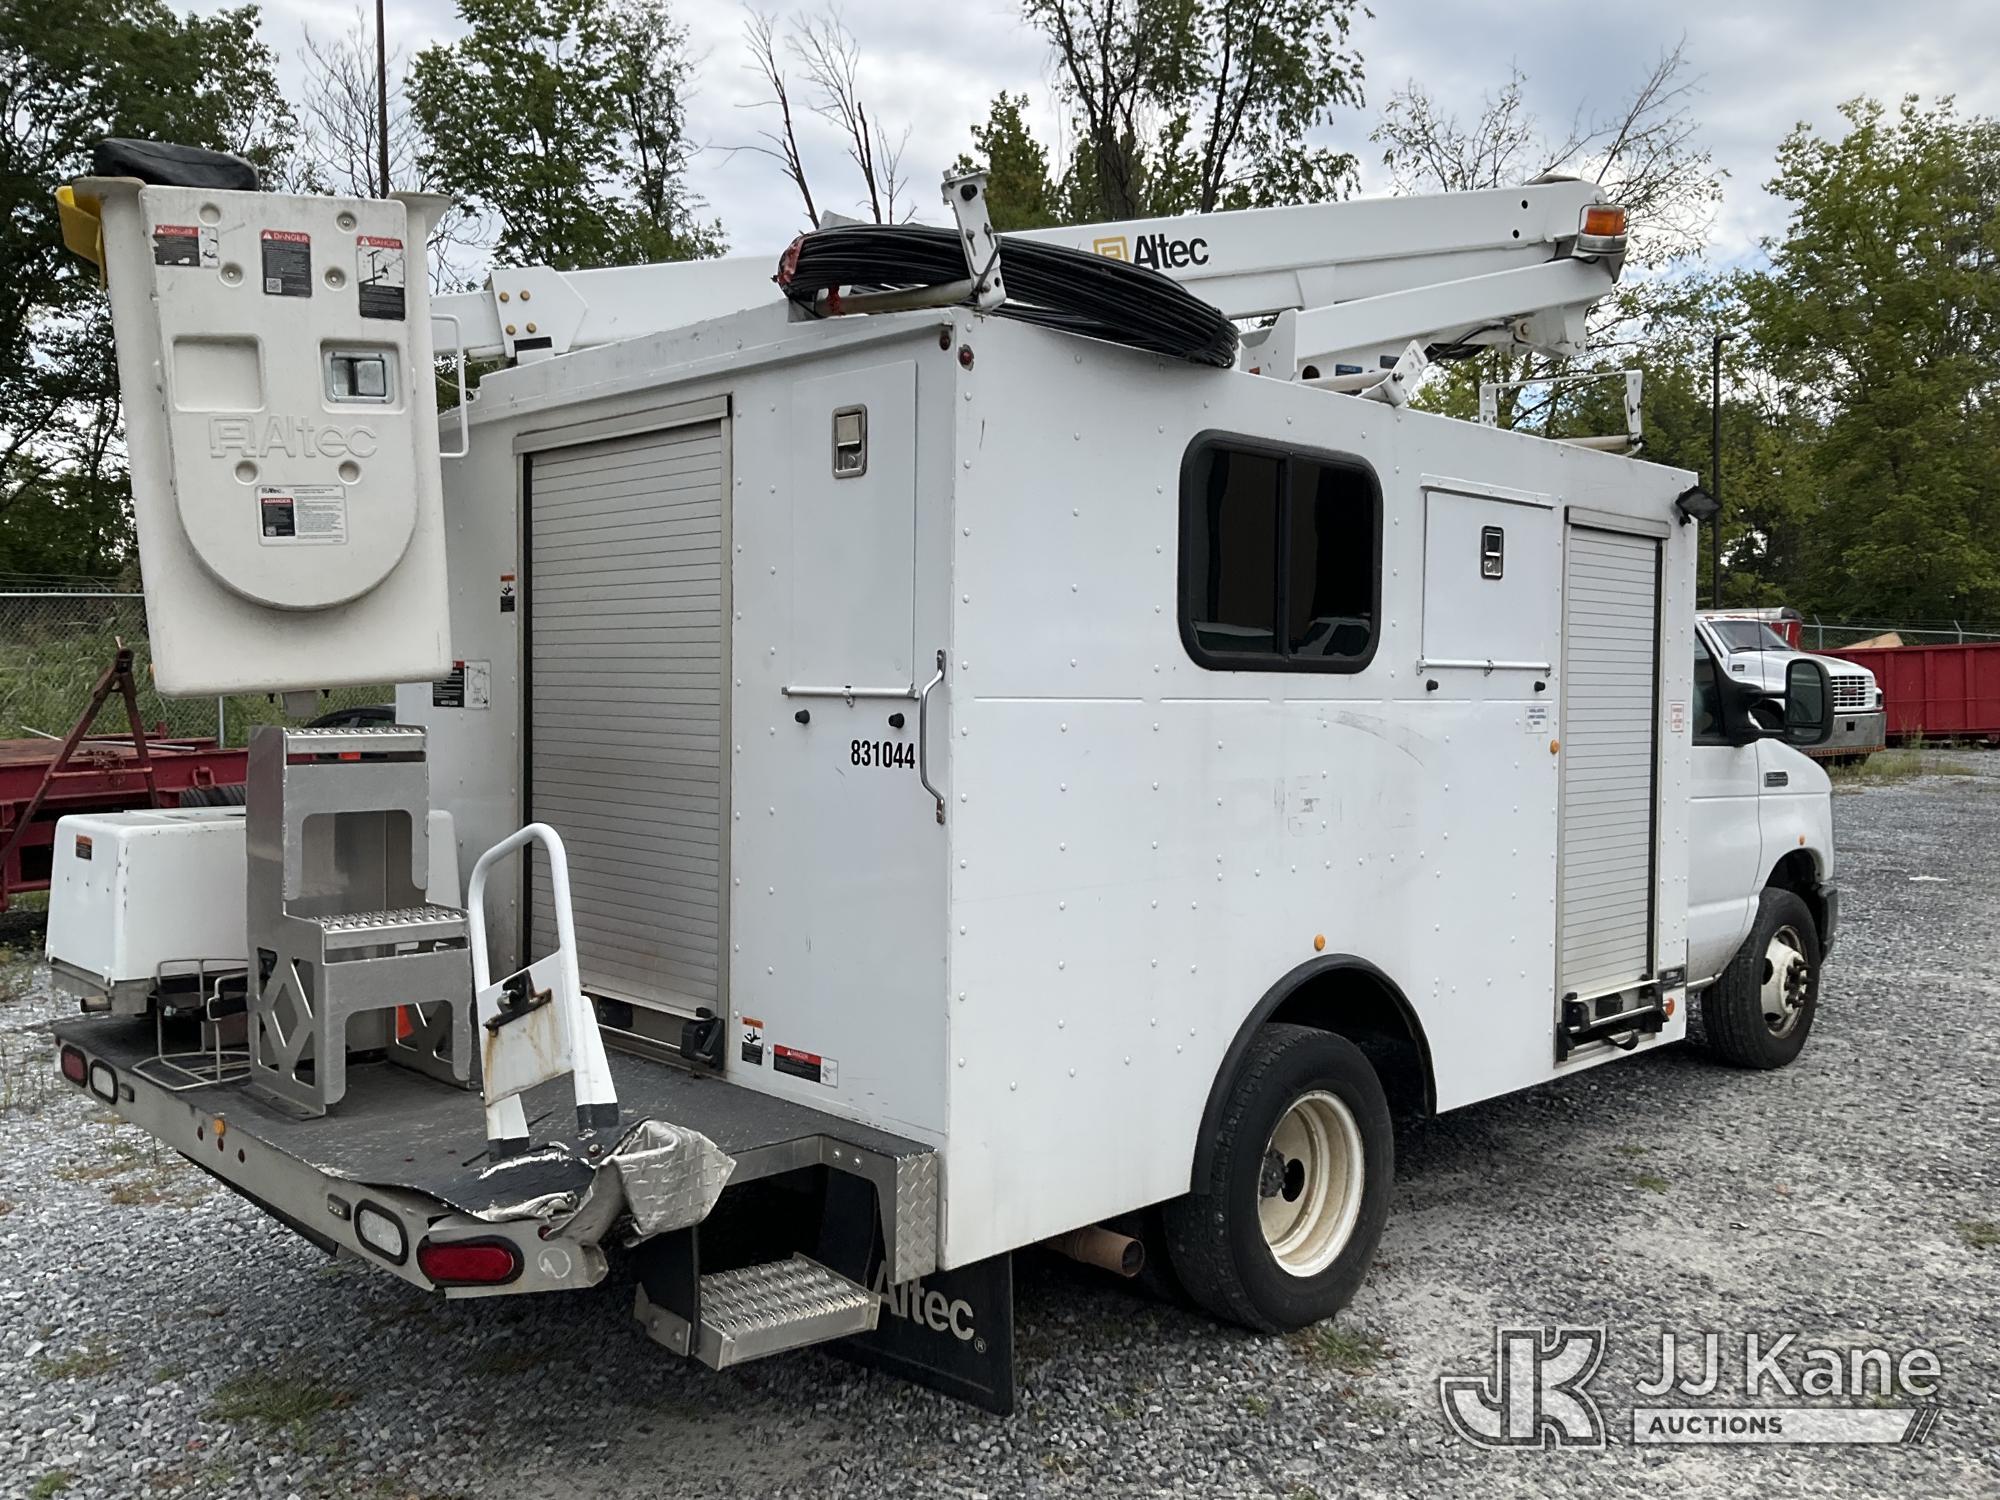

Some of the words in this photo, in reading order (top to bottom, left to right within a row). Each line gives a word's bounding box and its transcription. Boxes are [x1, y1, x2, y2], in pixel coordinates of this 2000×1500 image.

[273, 233, 309, 243] DANGER
[369, 239, 401, 248] DANGER
[1134, 233, 1209, 270] Altec
[258, 415, 378, 459] Altec
[851, 740, 916, 769] 831044
